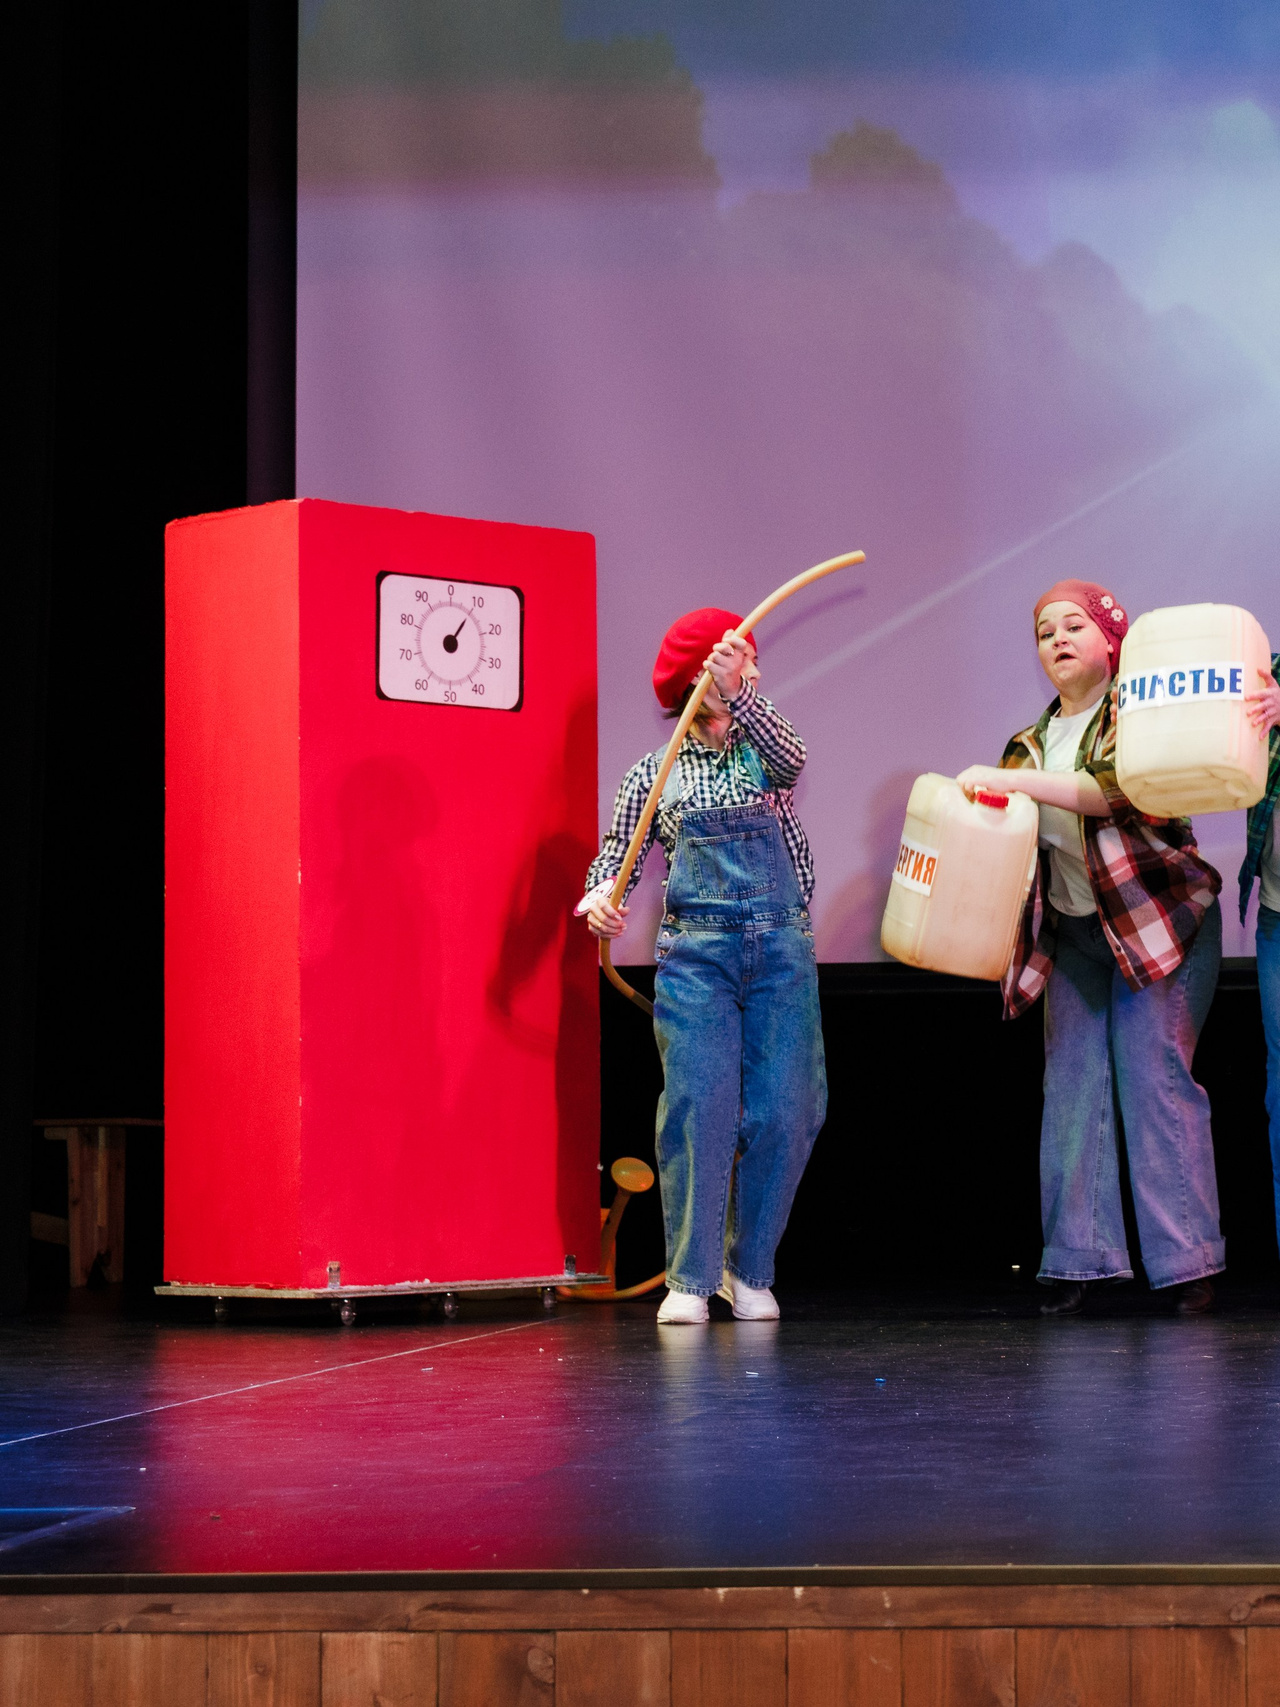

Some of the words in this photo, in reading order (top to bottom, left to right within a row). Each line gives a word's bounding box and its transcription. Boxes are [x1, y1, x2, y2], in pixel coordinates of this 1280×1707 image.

[415, 590, 429, 602] 90
[447, 584, 455, 596] 0
[472, 596, 485, 608] 10
[400, 613, 414, 625] 80
[488, 624, 502, 635] 20
[399, 648, 412, 660] 70
[488, 657, 502, 669] 30
[414, 679, 429, 691] 60
[471, 684, 485, 695] 40
[1118, 668, 1243, 709] СЧАСТЬЕ
[443, 691, 457, 703] 50
